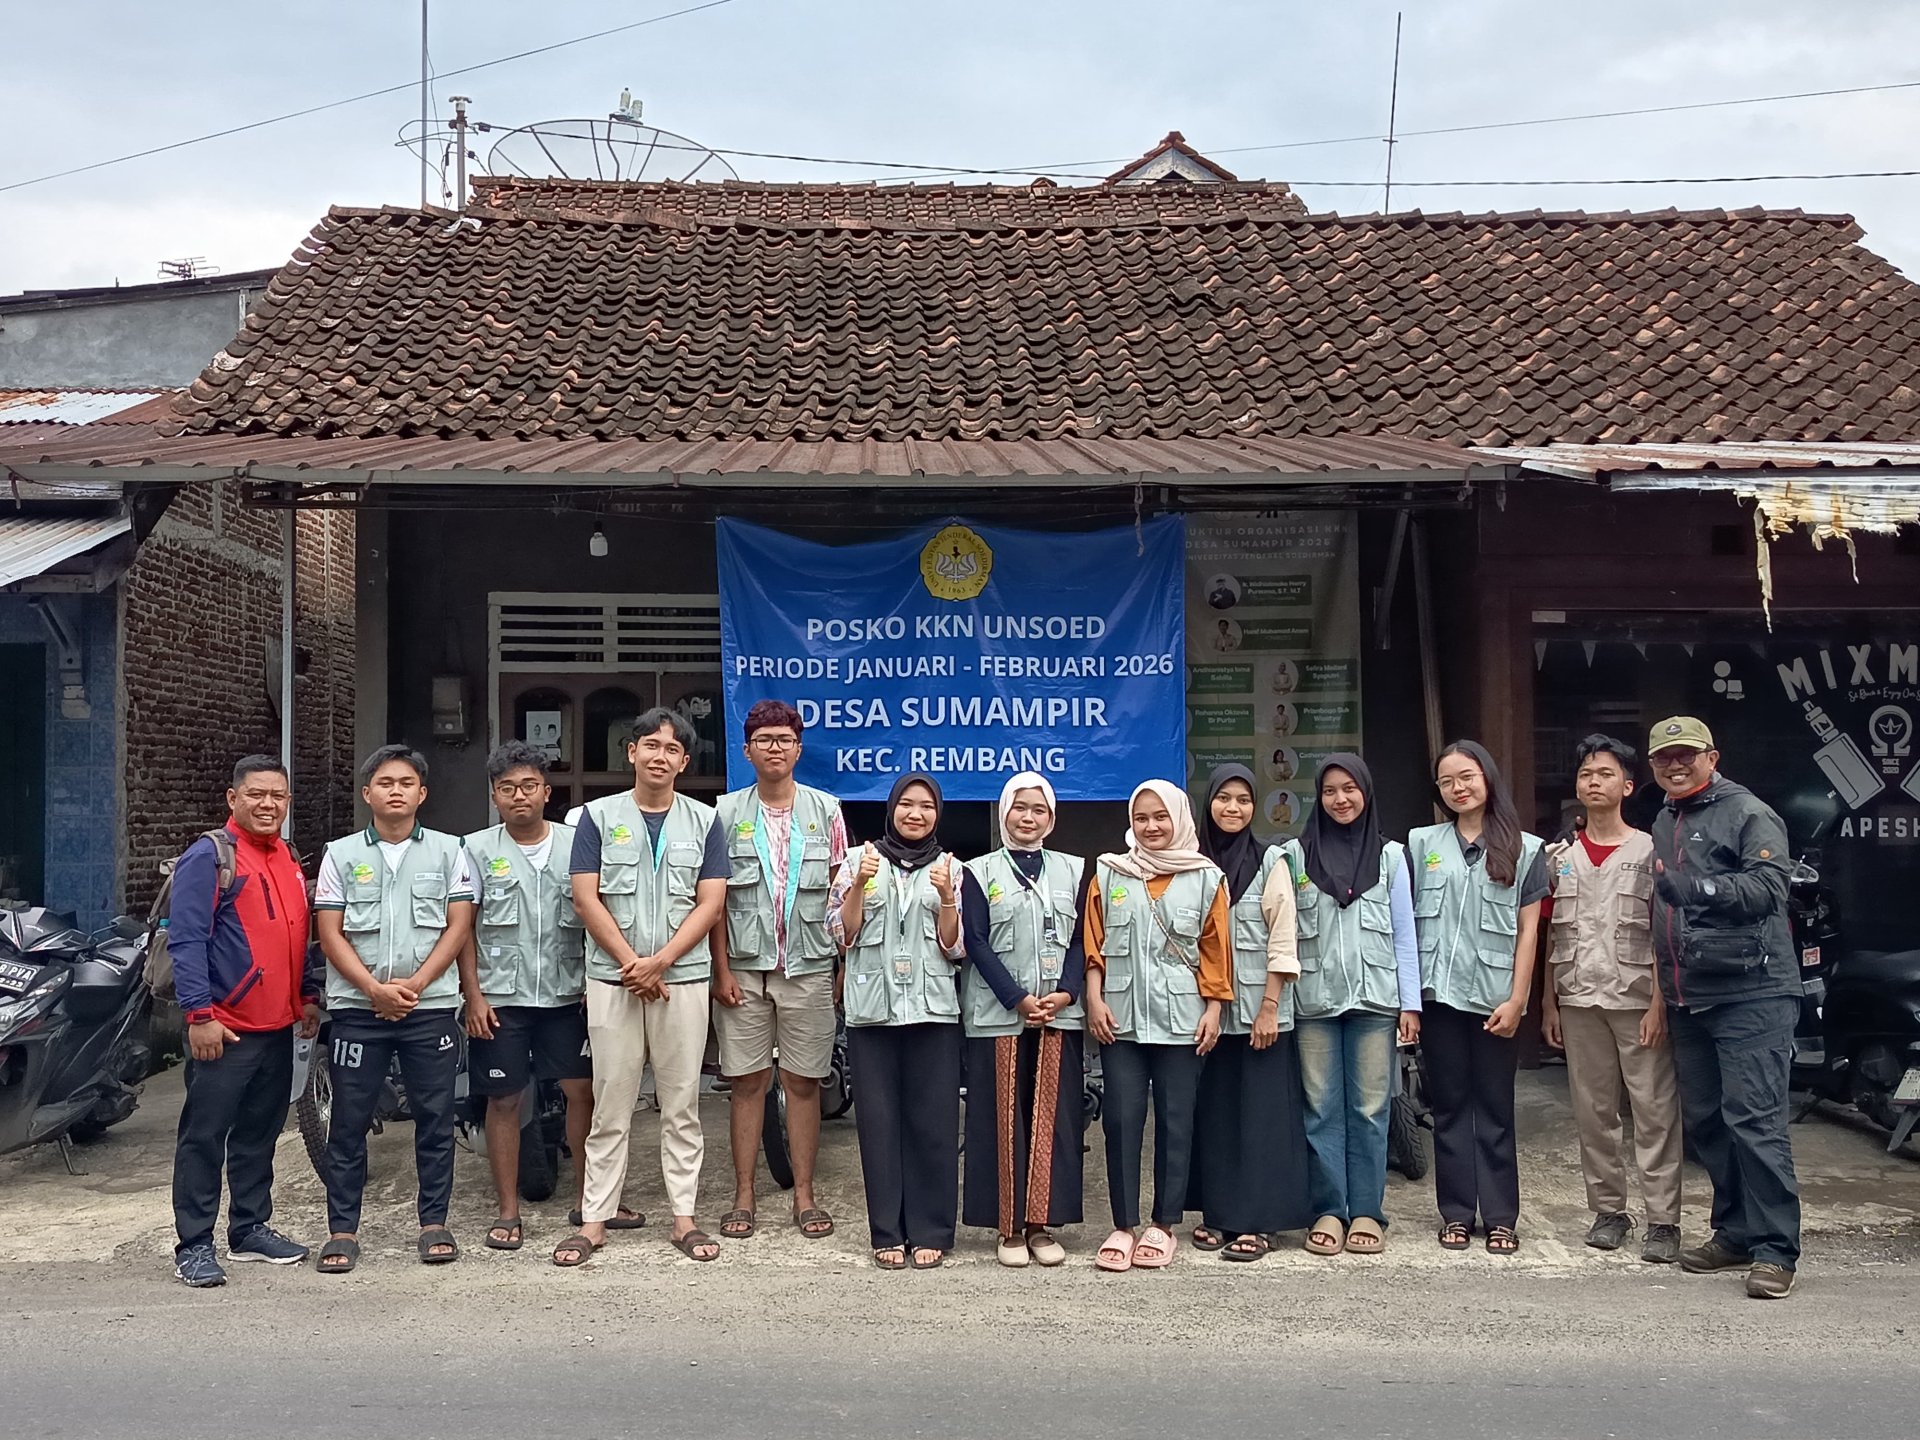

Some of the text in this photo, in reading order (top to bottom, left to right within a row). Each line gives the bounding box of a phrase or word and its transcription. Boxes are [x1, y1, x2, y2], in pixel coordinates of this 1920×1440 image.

[1185, 540, 1217, 549] DESA
[1223, 538, 1293, 549] SUMAMPIR
[1186, 527, 1231, 537] UKTUR
[1237, 525, 1319, 537] ORGANISASI
[1185, 553, 1238, 561] NIVERSITAS
[807, 614, 1106, 641] POSKO KKN UNSOED
[735, 655, 840, 679] PERIODE
[844, 655, 955, 684] JANUARI
[980, 655, 1105, 678] FEBRUARI
[1114, 653, 1174, 676] 2026
[796, 696, 1108, 728] DESA SUMAMPIR
[837, 747, 1065, 772] KEC. REMBANG
[8, 965, 32, 980] PVA
[333, 1038, 364, 1068] 119
